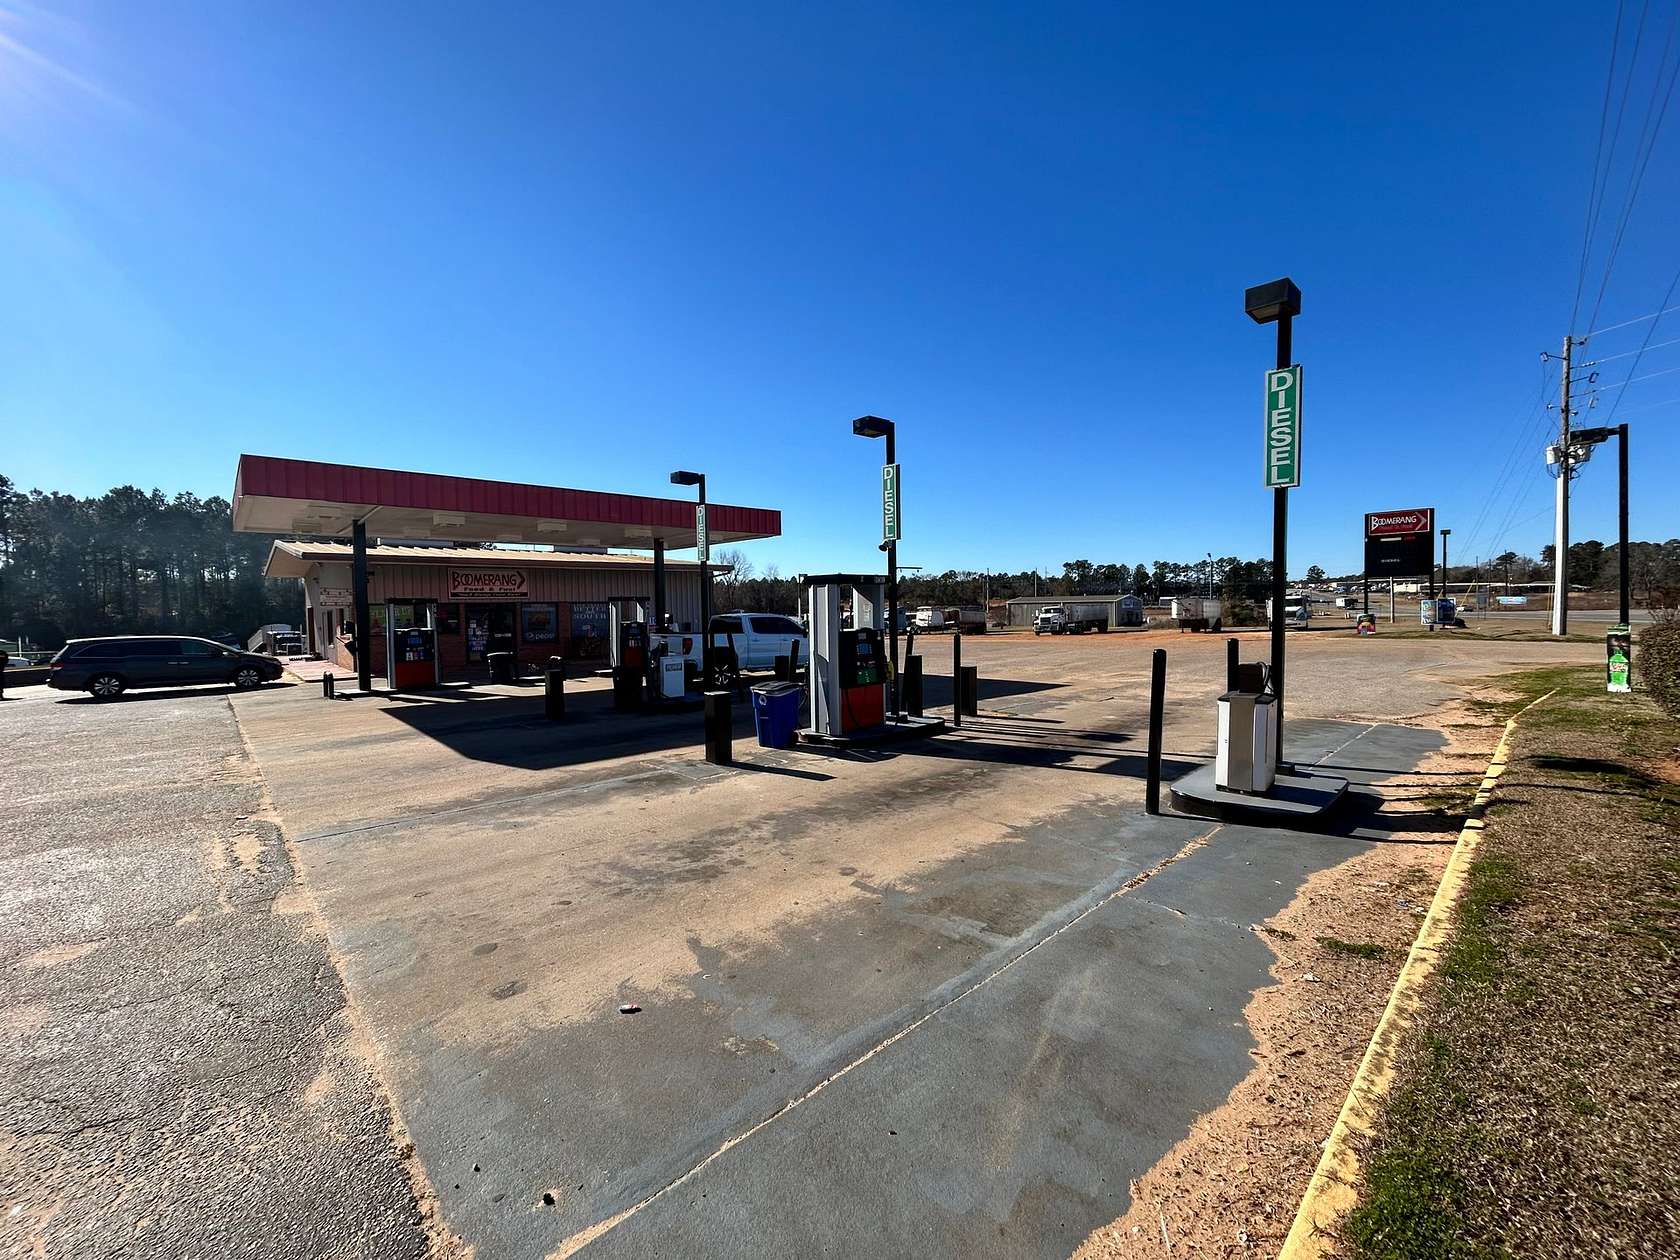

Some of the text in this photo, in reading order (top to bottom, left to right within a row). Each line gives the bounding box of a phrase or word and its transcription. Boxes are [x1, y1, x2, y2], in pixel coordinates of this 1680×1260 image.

[1270, 372, 1294, 484] DIESEL
[884, 467, 894, 537] DIESEL
[1370, 516, 1417, 531] BOOMERANG
[452, 571, 517, 590] BOOMERANG
